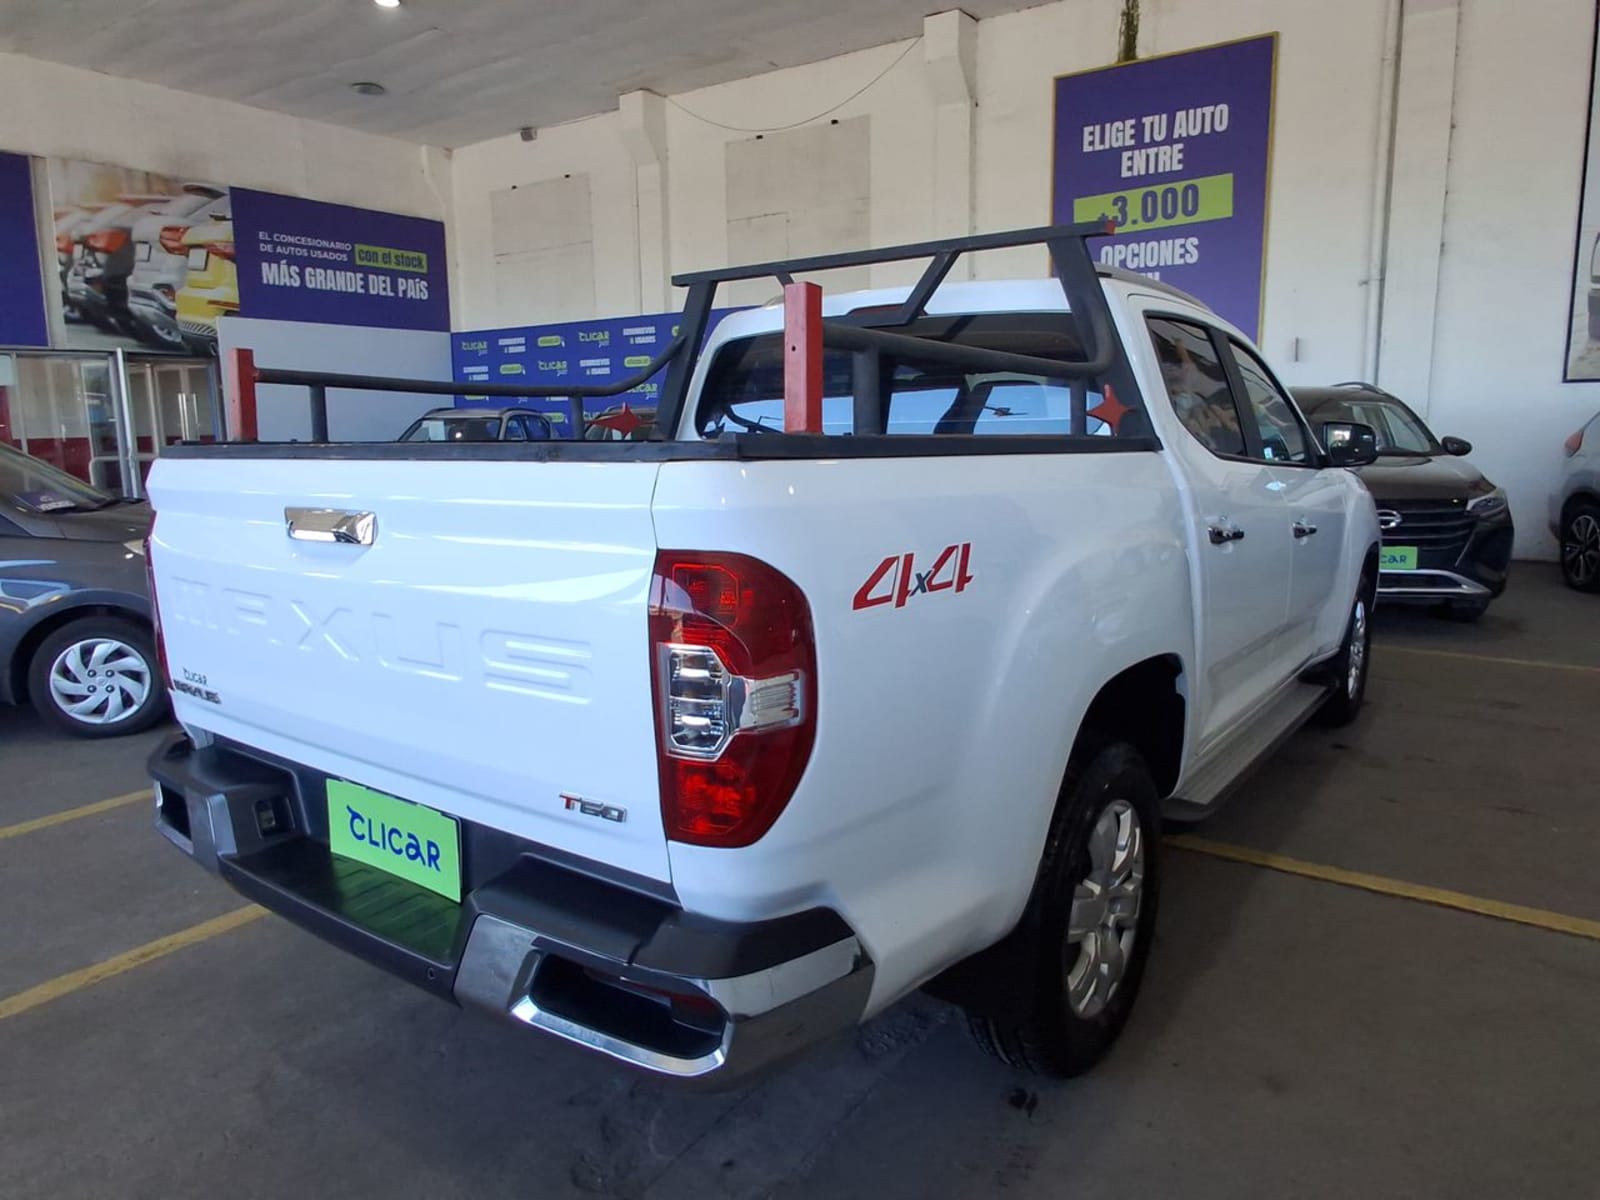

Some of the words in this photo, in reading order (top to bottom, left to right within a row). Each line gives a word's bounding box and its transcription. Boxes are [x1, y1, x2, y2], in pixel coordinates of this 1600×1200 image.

[1083, 118, 1136, 152] ELIGE
[1142, 113, 1168, 144] TU
[1173, 103, 1229, 139] AUTO
[1121, 143, 1184, 178] ENTRE
[259, 231, 271, 241] EL
[273, 233, 352, 251] CONCESIONARIO
[260, 243, 274, 253] DE
[276, 244, 308, 257] AUTOS
[310, 248, 348, 262] USADOS
[1100, 237, 1199, 269] OPCIONES
[358, 249, 379, 263] con
[382, 250, 392, 264] el
[394, 252, 424, 270] stock
[261, 260, 300, 287] MÁS
[305, 266, 365, 294] GRANDE
[369, 275, 395, 297] DEL
[398, 278, 429, 300] PAÍS
[852, 541, 974, 611] 4x4
